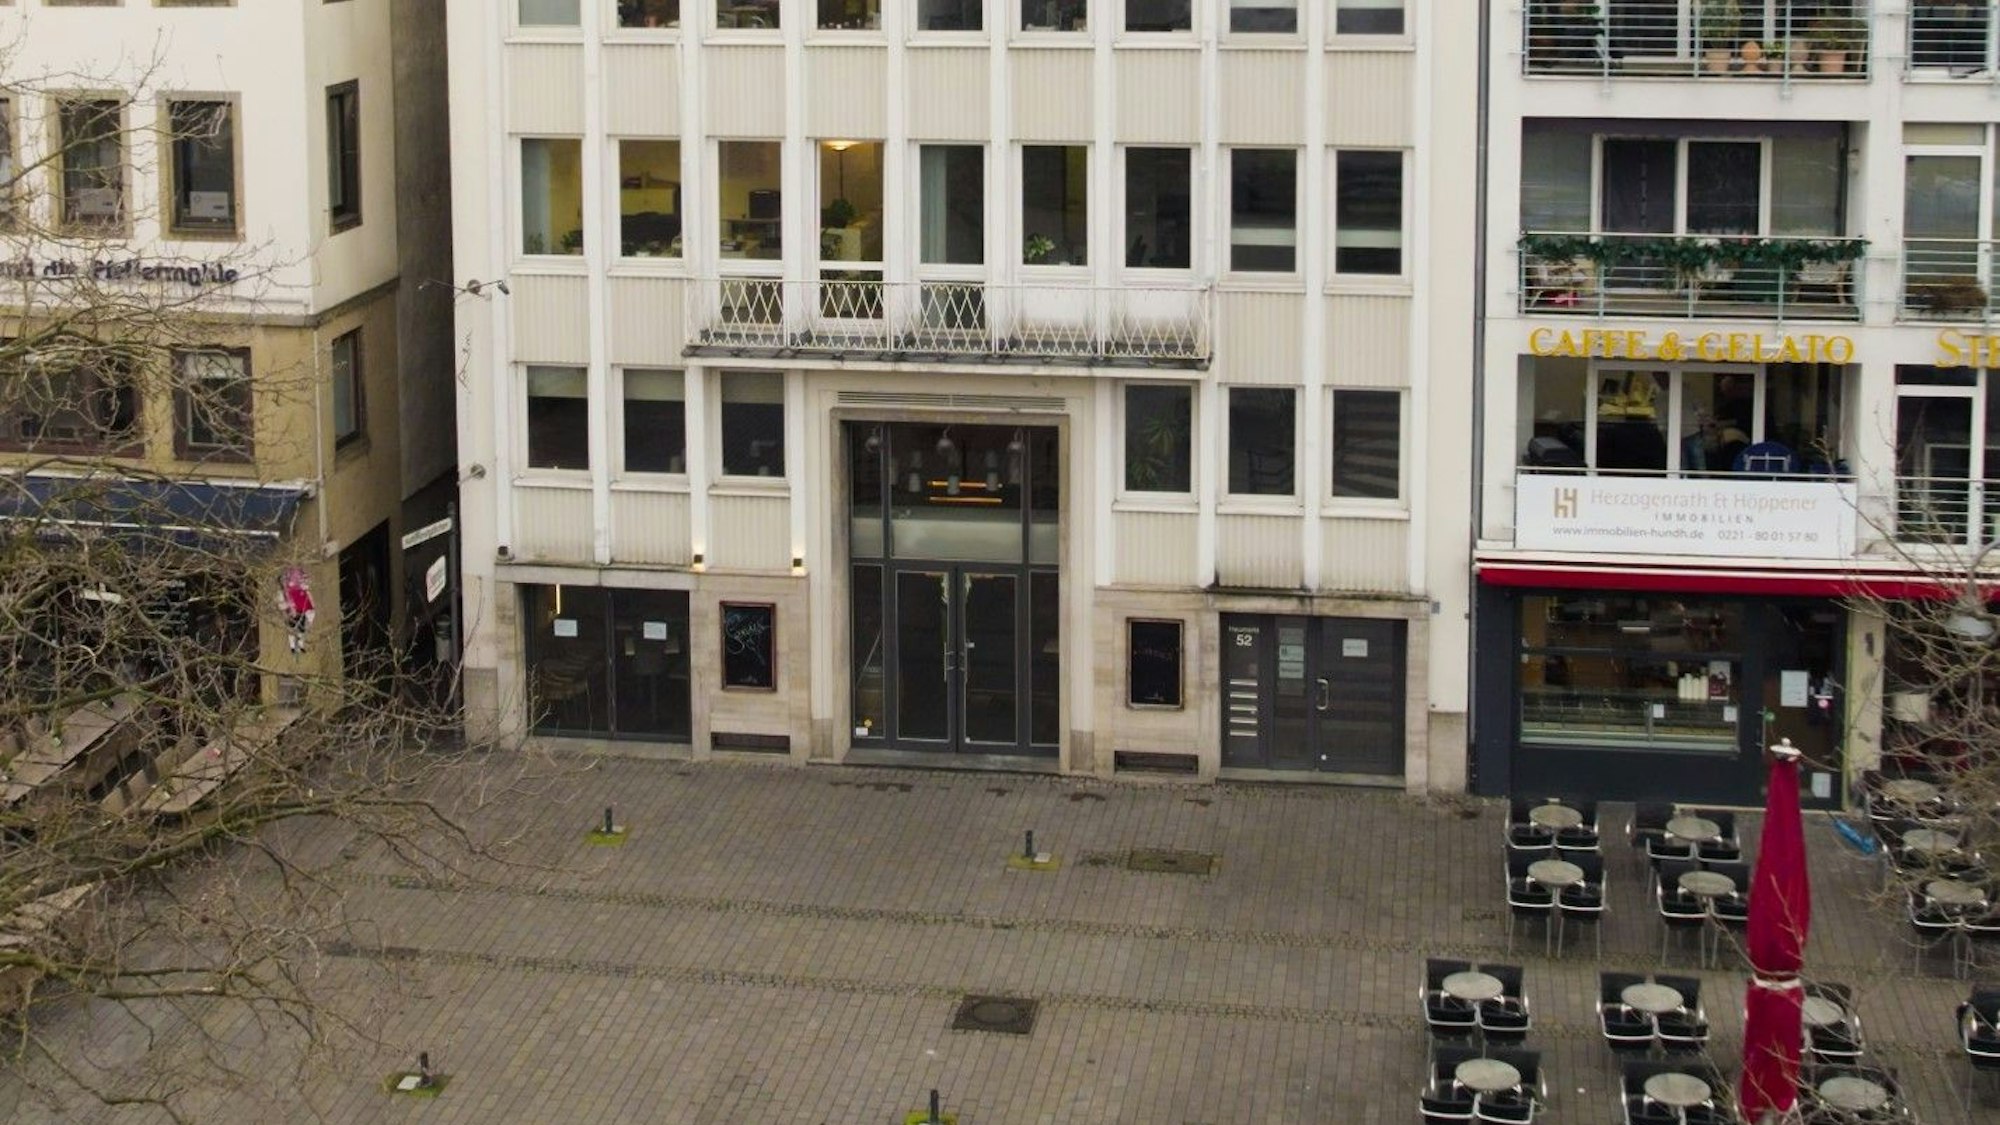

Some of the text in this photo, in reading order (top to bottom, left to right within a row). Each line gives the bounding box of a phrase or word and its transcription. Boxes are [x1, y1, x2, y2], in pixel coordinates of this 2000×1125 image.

[1529, 328, 1855, 364] CAFFE & GELATO
[1591, 489, 1707, 510] Herzogenrath
[1734, 493, 1818, 513] Höppener
[1655, 513, 1754, 524] IMMOBILIEN
[1552, 526, 1705, 540] www.immobilien-hundh.de
[1717, 530, 1744, 541] 0221
[1770, 532, 1784, 542] 01
[1236, 634, 1253, 646] 52
